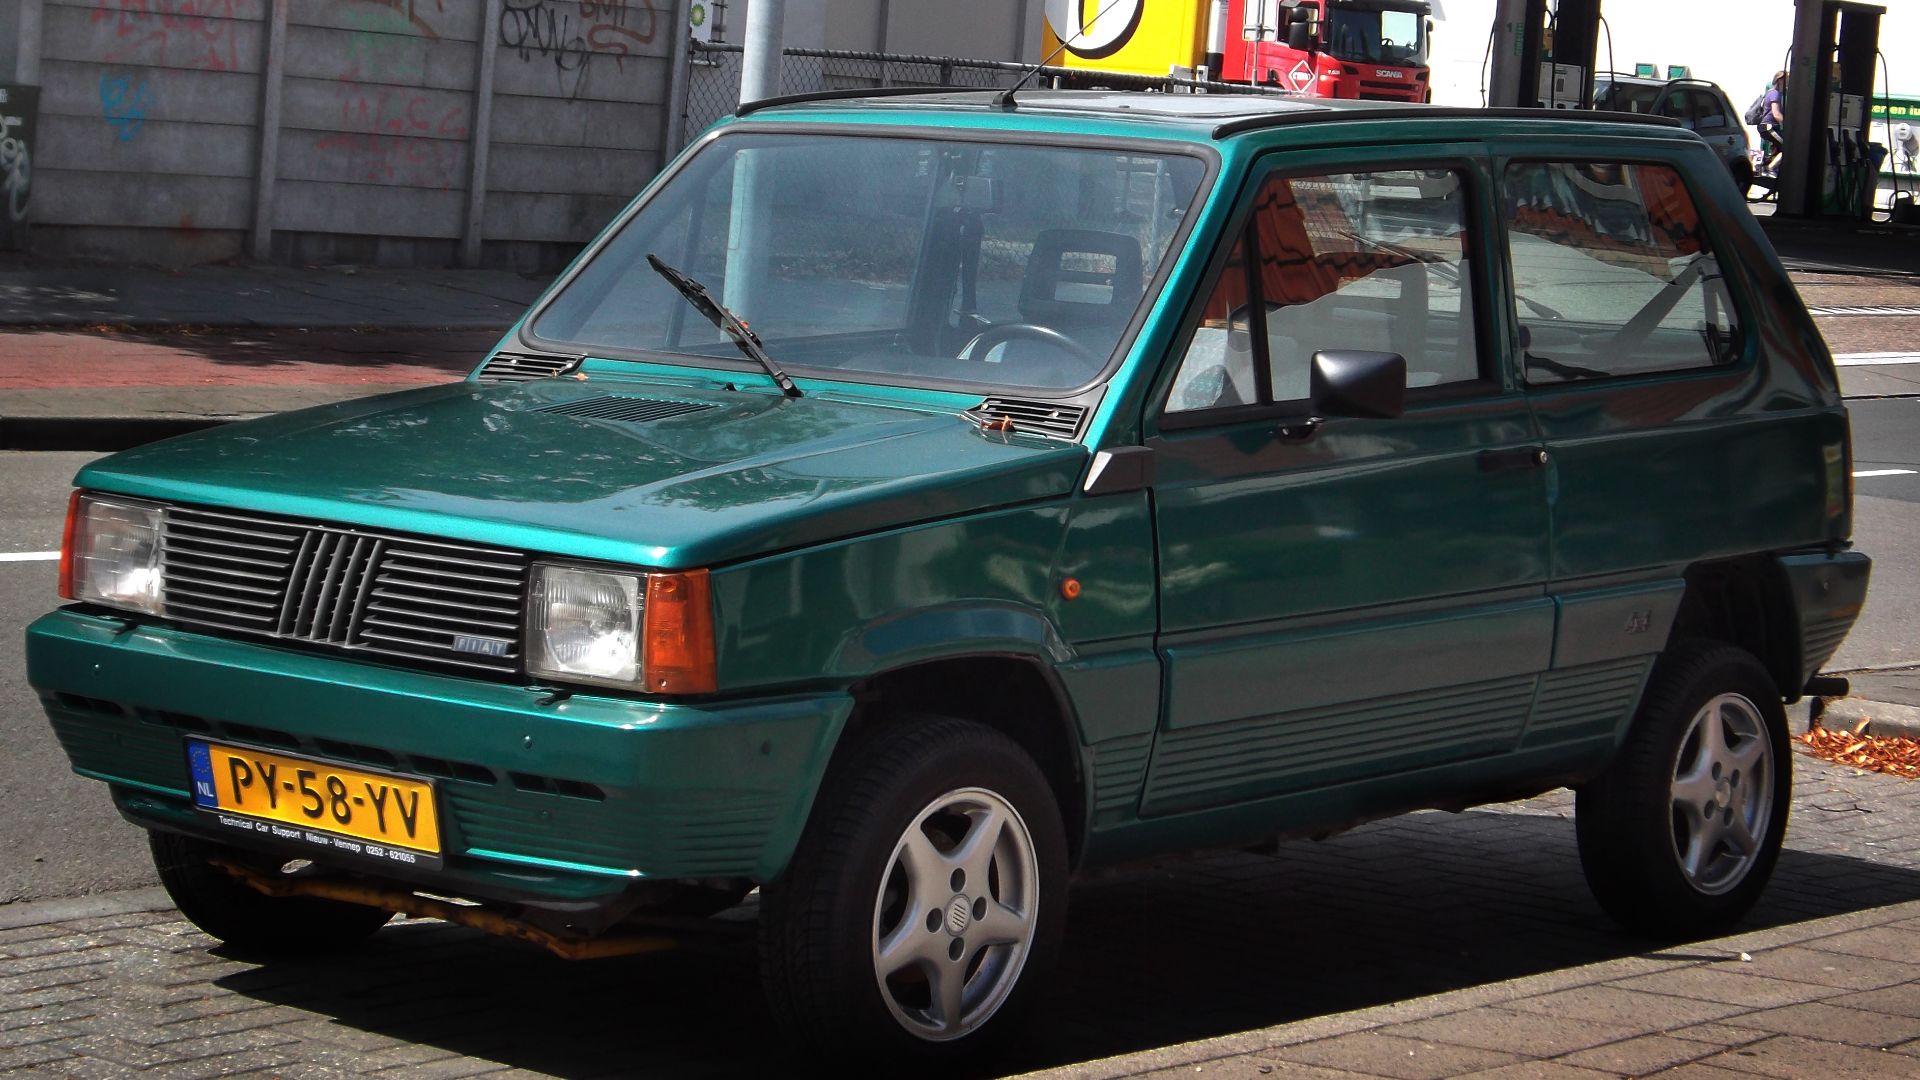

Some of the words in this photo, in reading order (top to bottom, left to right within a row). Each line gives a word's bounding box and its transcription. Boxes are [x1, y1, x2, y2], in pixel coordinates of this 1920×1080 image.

[1375, 69, 1403, 79] SCANIA
[1872, 105, 1887, 114] er
[1889, 106, 1907, 115] en
[457, 638, 505, 655] FIAT
[197, 781, 215, 798] NL
[227, 757, 419, 839] PY-58-YV
[218, 815, 253, 830] Technical
[255, 822, 269, 833] Car
[271, 825, 301, 839] Support
[365, 845, 384, 857] 0252
